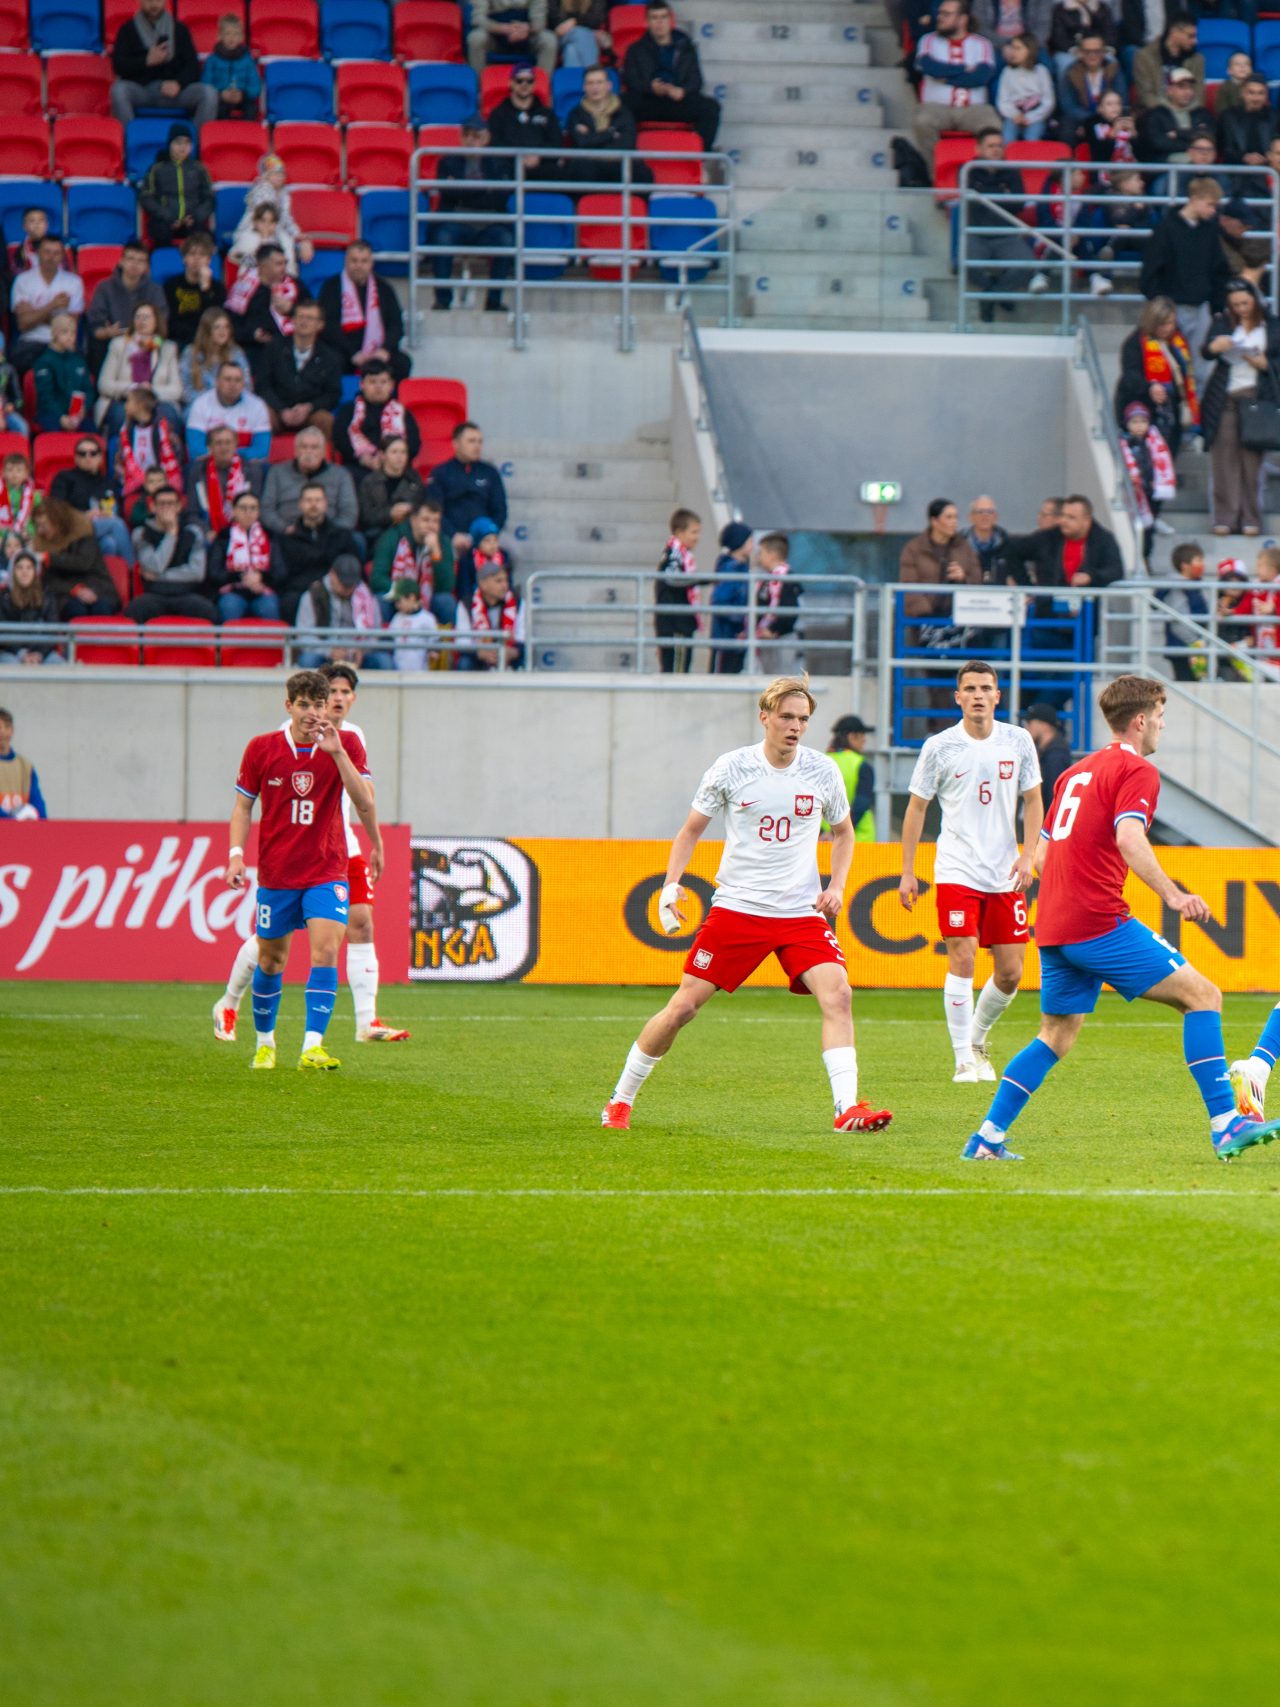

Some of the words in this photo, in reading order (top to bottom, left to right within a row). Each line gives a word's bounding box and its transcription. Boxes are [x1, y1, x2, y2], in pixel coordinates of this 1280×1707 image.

[701, 23, 715, 38] C
[771, 25, 790, 39] 12
[843, 26, 857, 41] C
[714, 84, 728, 99] C
[786, 86, 800, 100] 11
[857, 88, 872, 103] C
[797, 151, 818, 165] 10
[871, 152, 886, 167] C
[886, 215, 900, 230] C
[756, 276, 770, 291] C
[902, 280, 916, 295] C
[501, 462, 514, 477] C
[515, 525, 528, 540] C
[542, 651, 556, 667] C
[979, 781, 992, 805] 6
[291, 799, 315, 826] 18
[1052, 771, 1093, 842] 6
[759, 815, 791, 842] 20
[16, 836, 258, 972] piłka
[1014, 900, 1027, 926] 6
